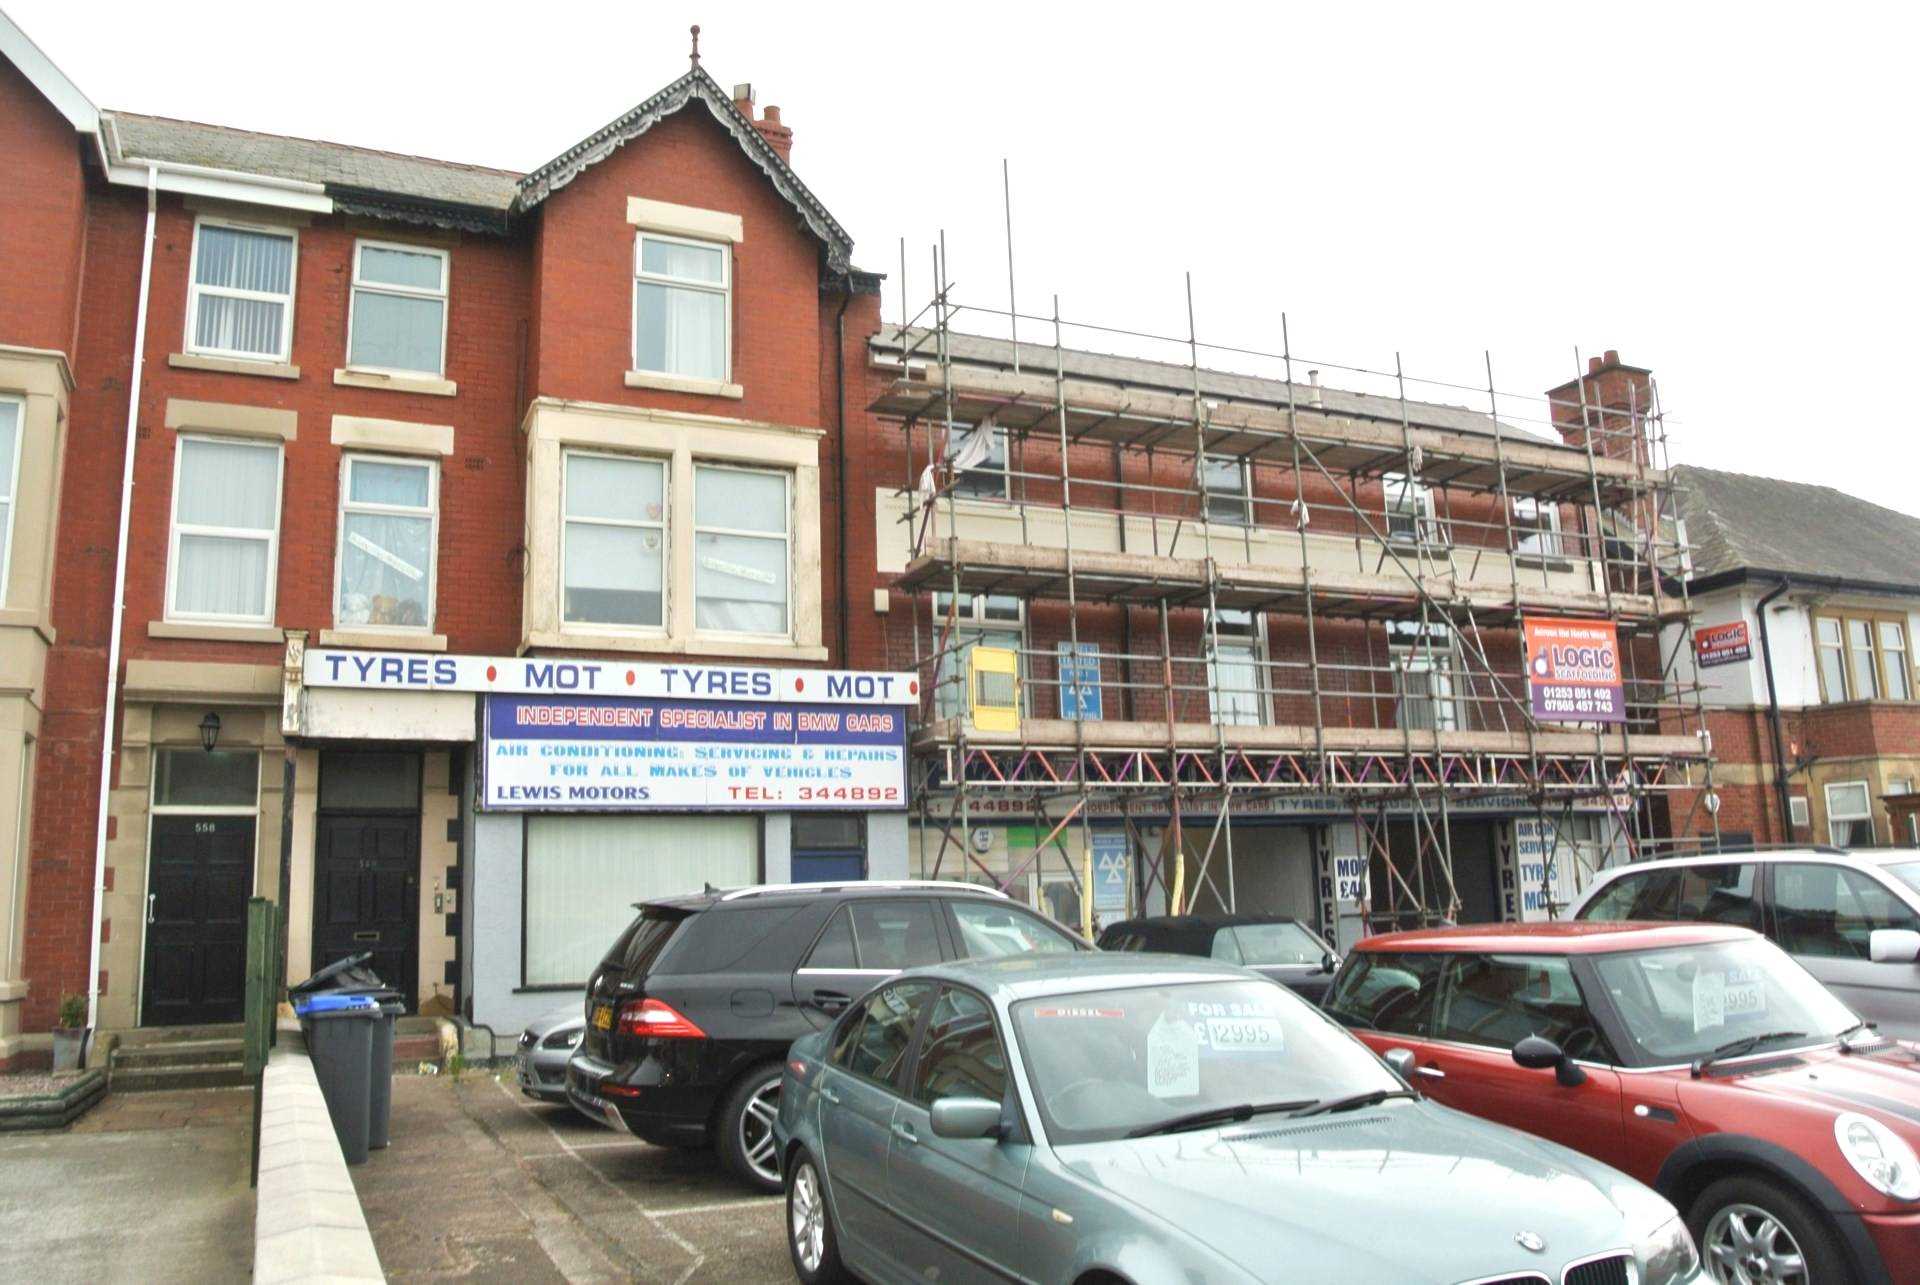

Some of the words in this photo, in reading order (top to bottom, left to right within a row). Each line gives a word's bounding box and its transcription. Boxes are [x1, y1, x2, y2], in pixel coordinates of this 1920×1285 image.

[1552, 645, 1615, 669] LOGIC
[325, 655, 457, 685] TYRES
[525, 663, 602, 691] MOT
[660, 669, 772, 696] TYRES
[827, 675, 894, 699] MOT
[516, 705, 653, 728] INDEPENDENT
[660, 708, 767, 731] SPECIALIST
[774, 712, 792, 731] IN
[798, 712, 840, 732] BMW
[846, 714, 893, 733] CARS
[496, 744, 528, 756] AIR
[694, 746, 792, 760] SERVICING
[824, 748, 898, 761] REPAIRS
[550, 764, 589, 777] FOR
[600, 764, 638, 777] ALL
[649, 764, 718, 778] MAKES
[728, 766, 751, 778] OF
[763, 767, 853, 779] VEHICLES
[497, 785, 562, 800] LEWIS
[568, 786, 651, 800] MOTORS
[727, 787, 782, 801] TEL:
[798, 787, 898, 800] 344892
[957, 800, 1038, 813] 44892
[1498, 820, 1516, 922] TYRE
[1521, 863, 1557, 881] TYRS
